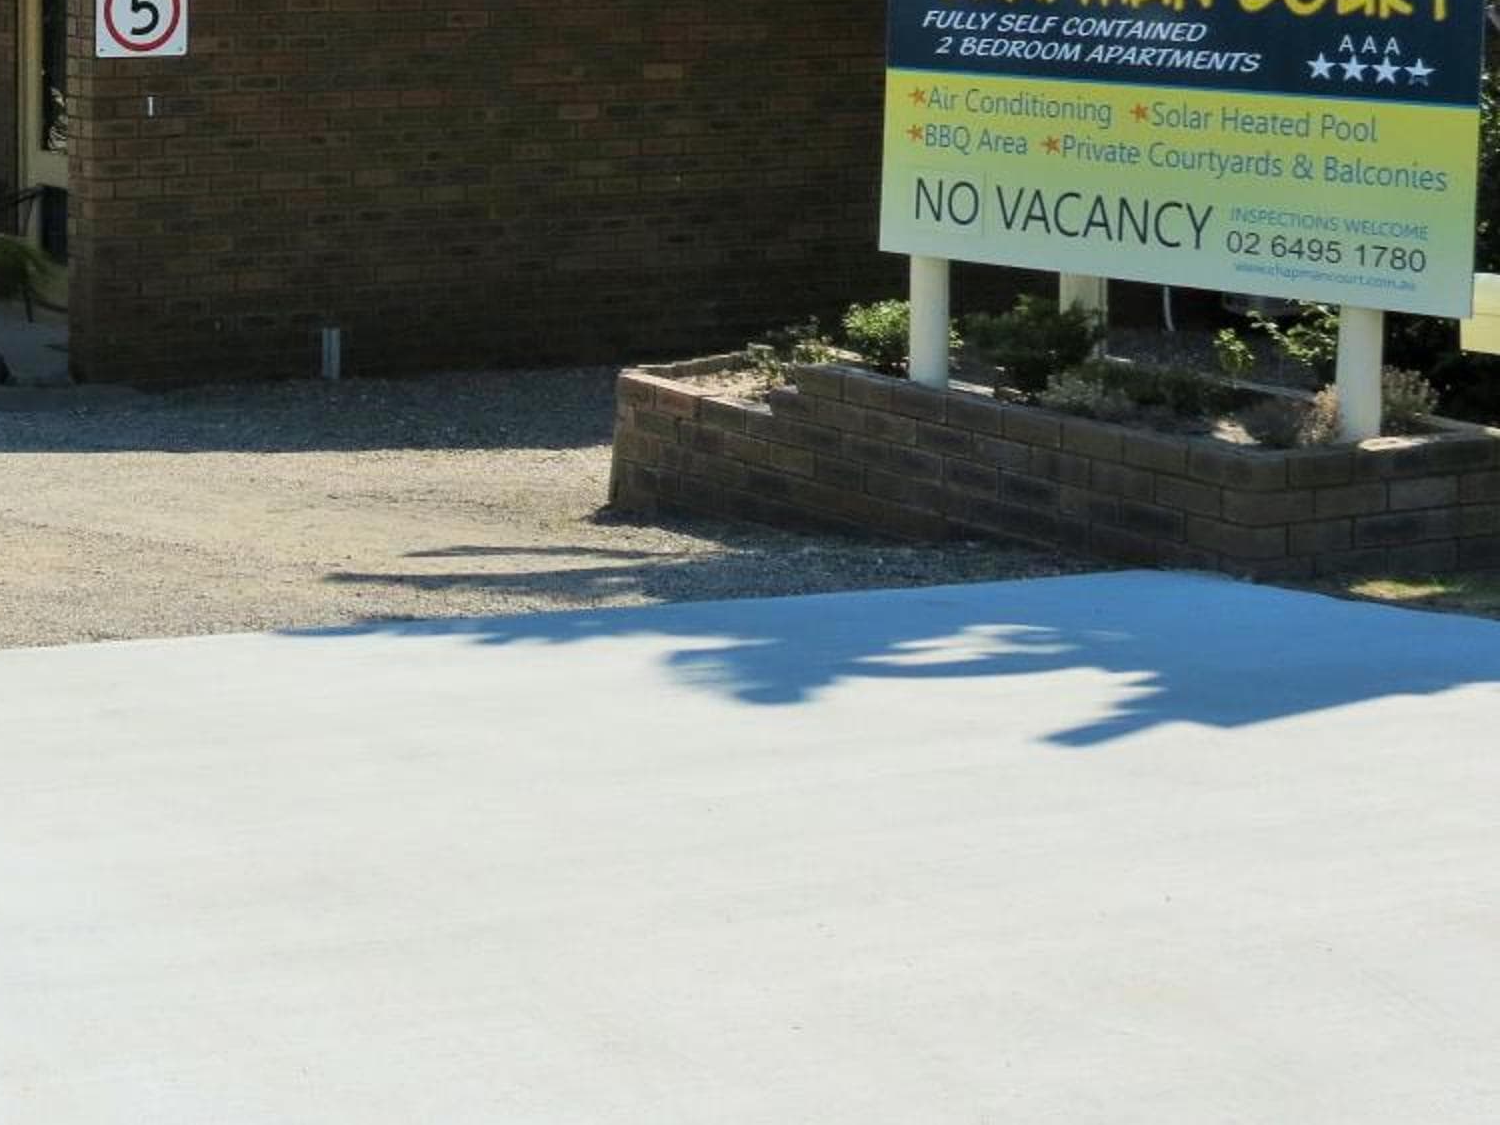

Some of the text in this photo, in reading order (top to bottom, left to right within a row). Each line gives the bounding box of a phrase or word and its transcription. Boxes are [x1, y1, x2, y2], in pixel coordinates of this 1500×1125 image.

[922, 10, 1208, 43] FULLY SELF CONTAINED
[935, 37, 1262, 73] 2 BEDROOM APARTMENTS
[926, 85, 1113, 130] Air Conditioning
[1151, 101, 1378, 143] Solar Heated Pool
[925, 123, 1029, 156] BBQ Area
[1062, 134, 1449, 192] Private Courtyards & Balconies
[915, 176, 1213, 251] NO VACANCY
[1231, 206, 1429, 241] INSPECTIONS WELCOME
[1226, 230, 1427, 273] 02 6495 1780
